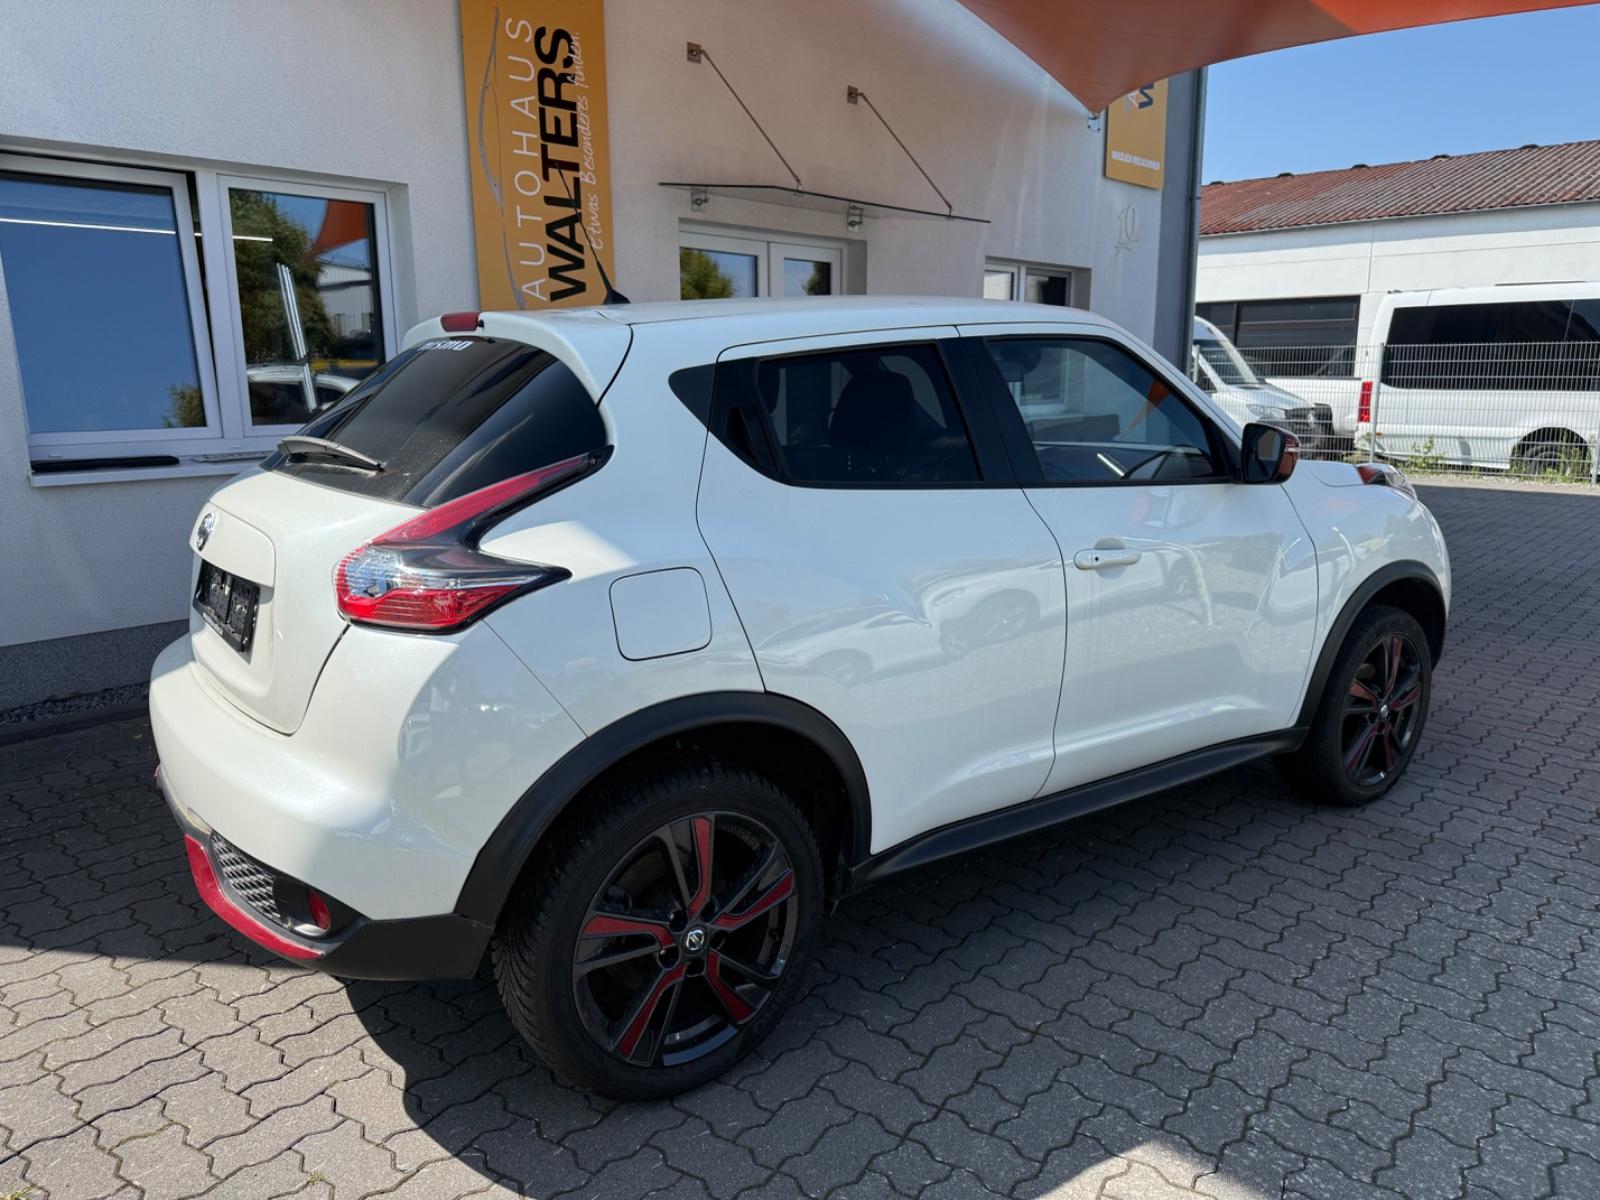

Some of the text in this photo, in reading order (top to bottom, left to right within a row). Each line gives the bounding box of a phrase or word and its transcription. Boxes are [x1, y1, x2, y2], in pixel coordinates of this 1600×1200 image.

[505, 18, 547, 301] AUTOHAUS
[534, 26, 586, 302] WALTERS
[576, 95, 597, 185] Besonderes
